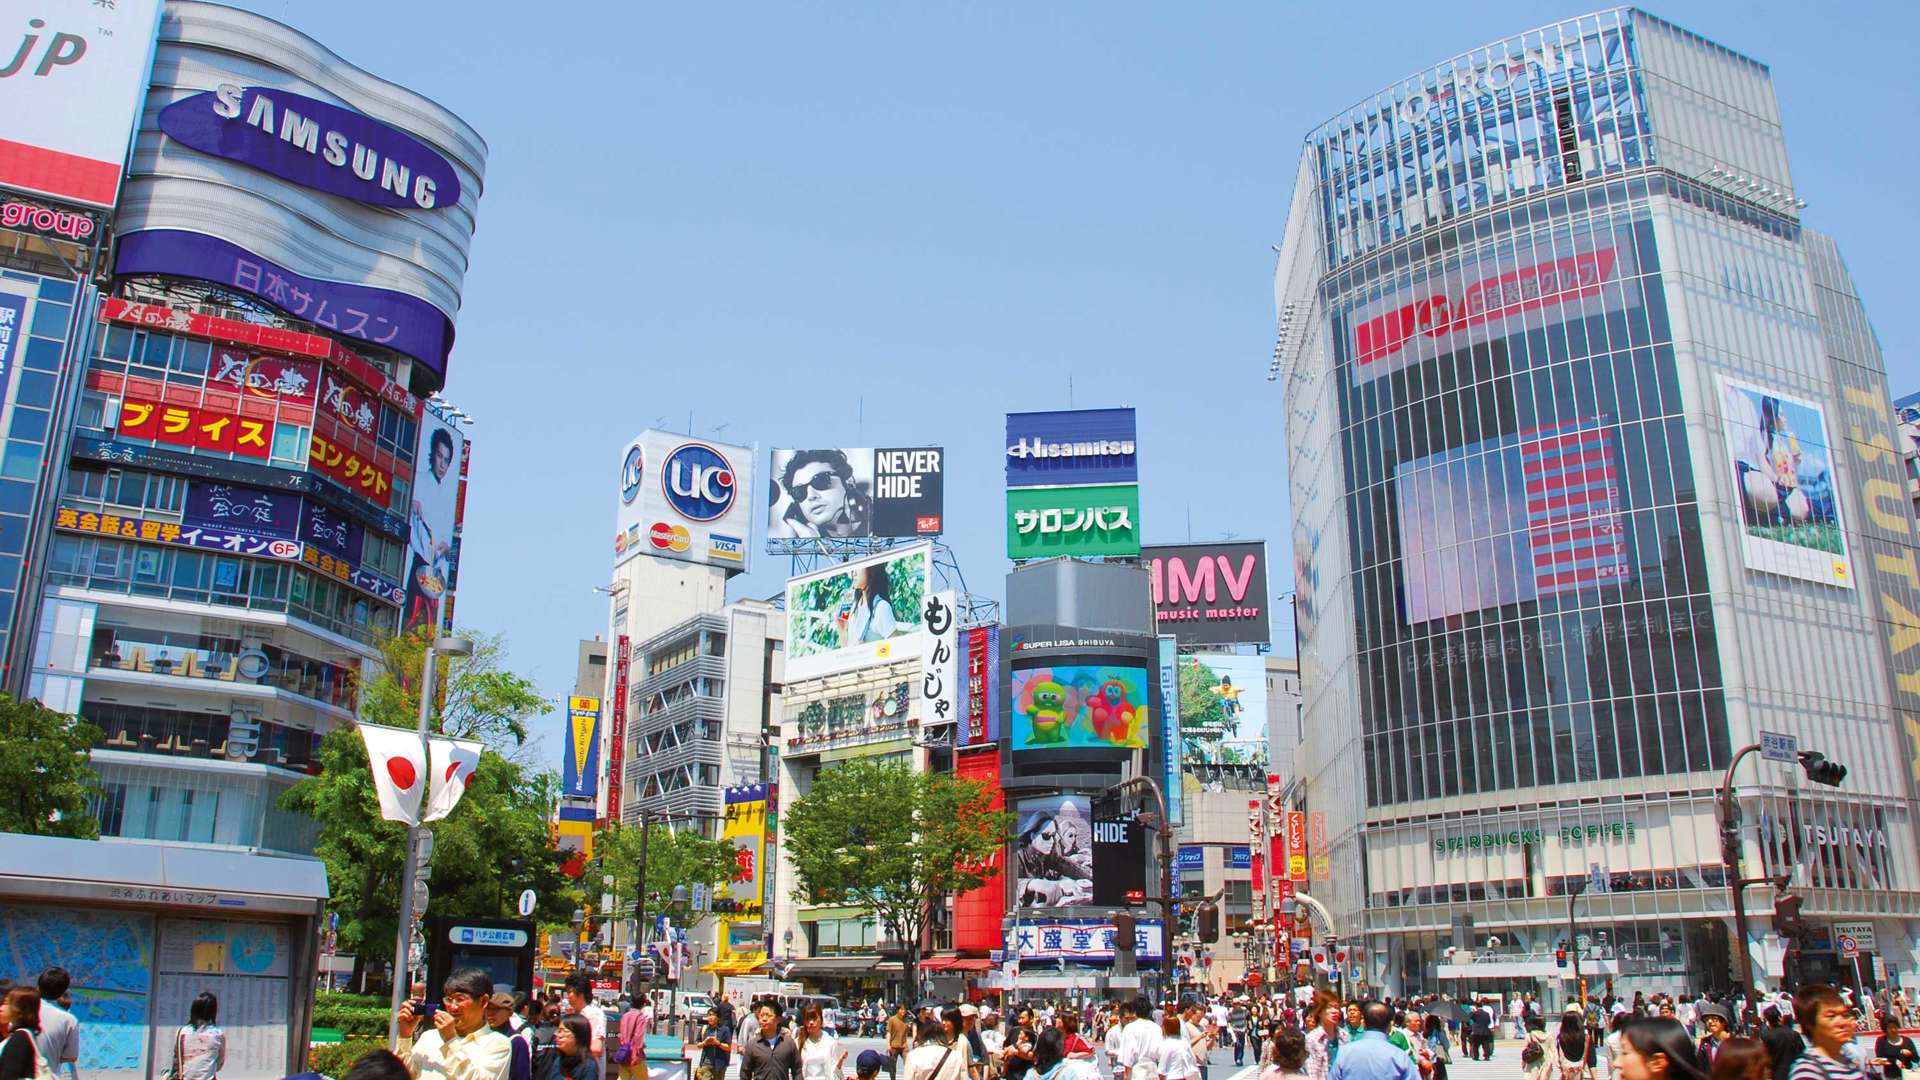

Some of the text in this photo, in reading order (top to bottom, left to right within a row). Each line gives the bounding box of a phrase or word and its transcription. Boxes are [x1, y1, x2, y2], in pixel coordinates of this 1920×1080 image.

[213, 83, 436, 209] SAMSUNG
[1, 203, 94, 240] group
[233, 260, 399, 343] 日本サムスン
[123, 403, 265, 447] プライス
[1007, 437, 1135, 458] Hisamitsu
[311, 435, 389, 494] コンタクト
[877, 451, 940, 474] NEVER
[877, 475, 922, 499] HIDE
[1014, 506, 1133, 534] サロンパス
[181, 528, 268, 553] イーオン
[273, 544, 297, 554] 6F
[715, 541, 737, 552] VISA
[303, 547, 350, 581] 英会話
[350, 569, 393, 598] イーオン
[1157, 606, 1259, 620] music master
[924, 596, 952, 718] もんじゃ
[1023, 641, 1053, 650] SUPER
[1054, 639, 1075, 647] LISA
[1161, 664, 1175, 720] Taisei
[1093, 822, 1129, 843] HIDE
[1435, 821, 1636, 852] STARBUCKS COFFEE
[1803, 825, 1887, 848] TSUTAYA
[1836, 926, 1872, 934] TSUTAYA
